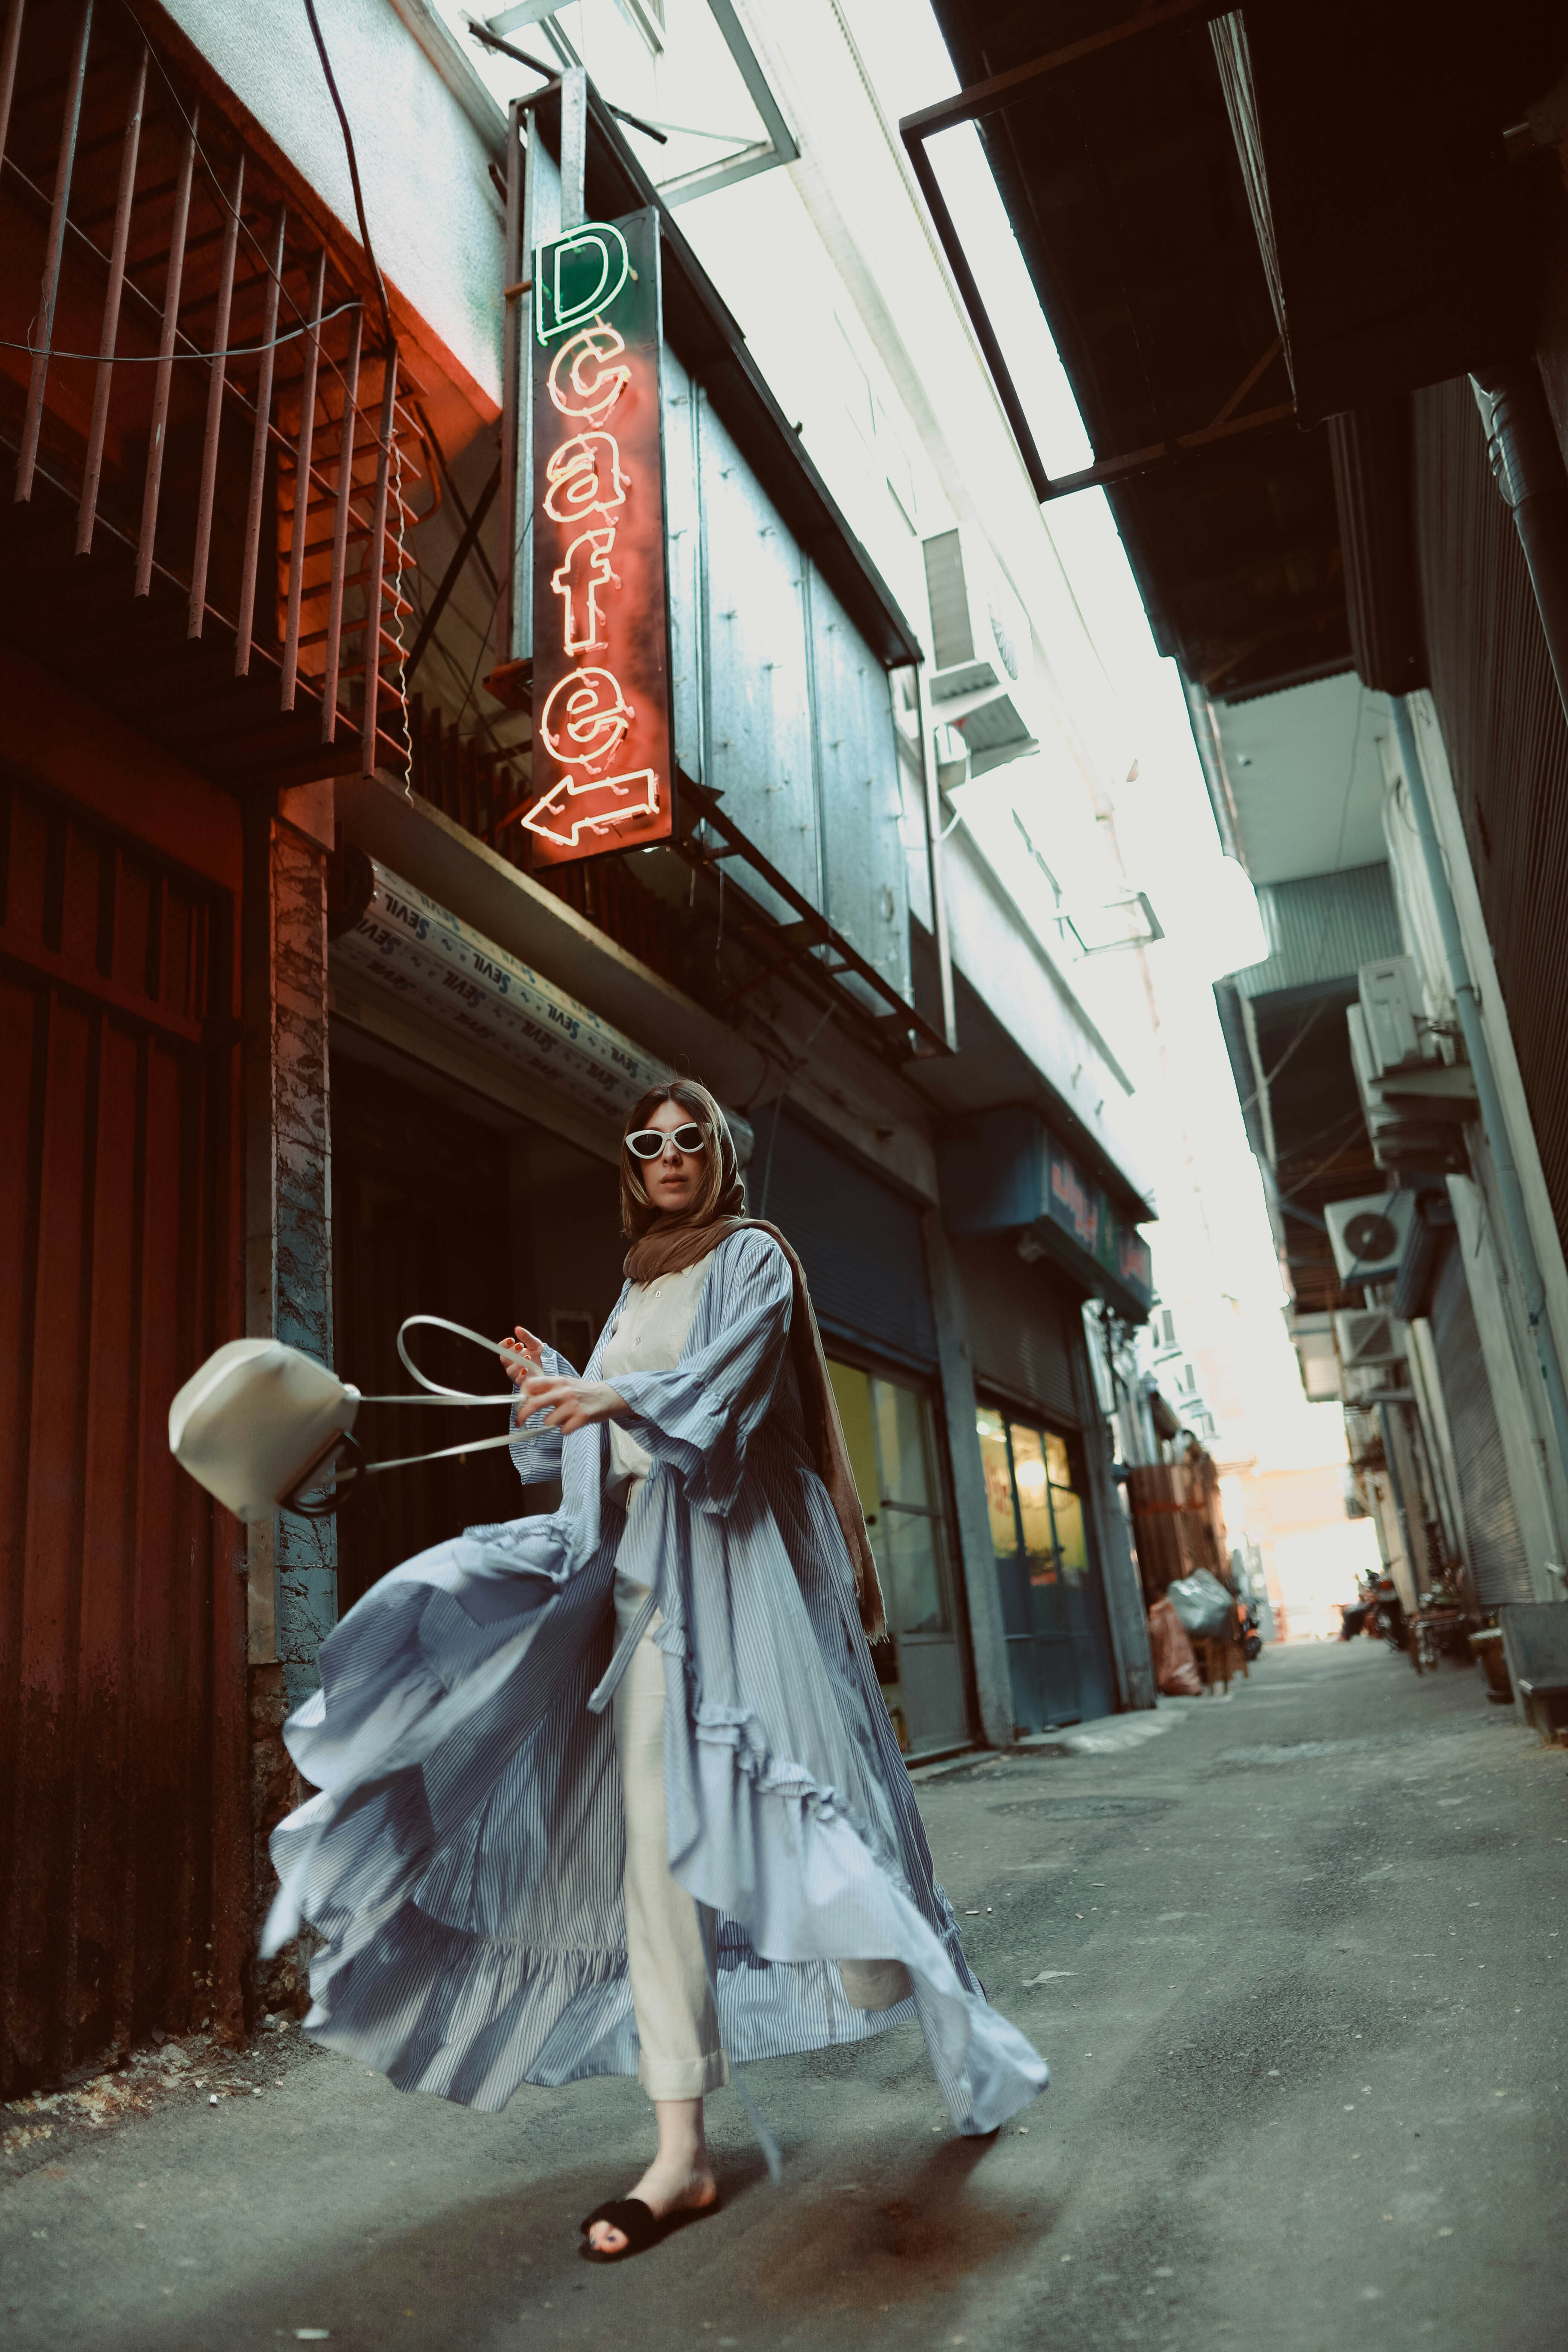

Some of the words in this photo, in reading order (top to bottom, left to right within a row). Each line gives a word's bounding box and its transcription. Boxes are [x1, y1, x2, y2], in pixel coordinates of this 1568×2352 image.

[385, 894, 430, 940] SEVIL
[443, 970, 486, 1009] SEVIL
[473, 953, 511, 994] SEVIL
[548, 1003, 580, 1040] SEVIL
